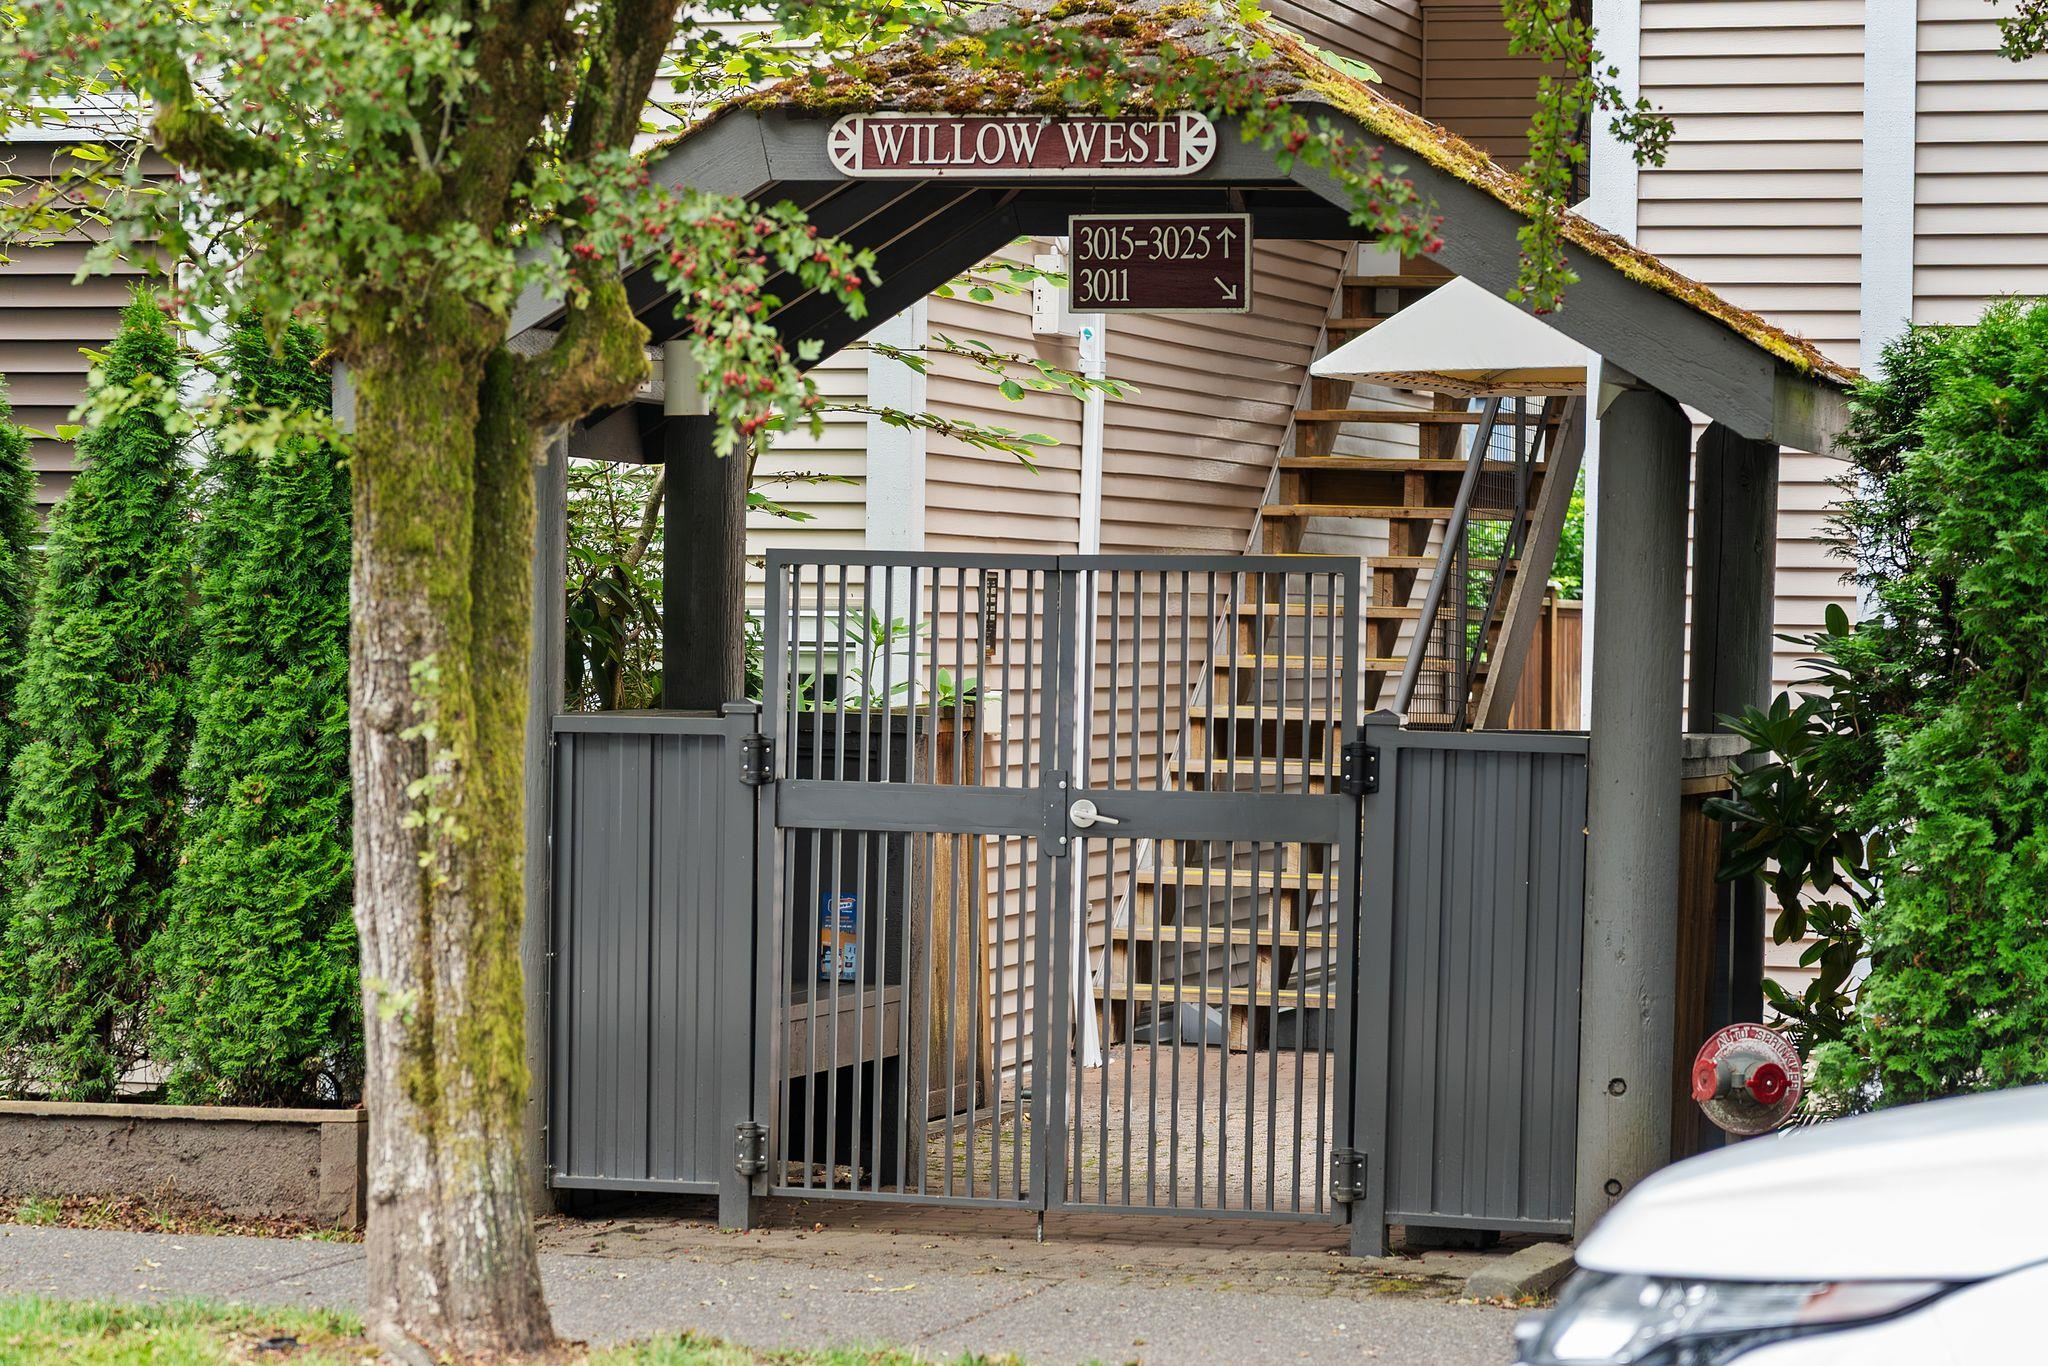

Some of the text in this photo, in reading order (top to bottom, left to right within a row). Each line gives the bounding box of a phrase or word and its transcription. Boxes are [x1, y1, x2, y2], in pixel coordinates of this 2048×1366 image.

[868, 120, 1176, 166] WILLOW WEST
[1079, 225, 1212, 262] 3015-3025
[1079, 268, 1131, 303] 3011
